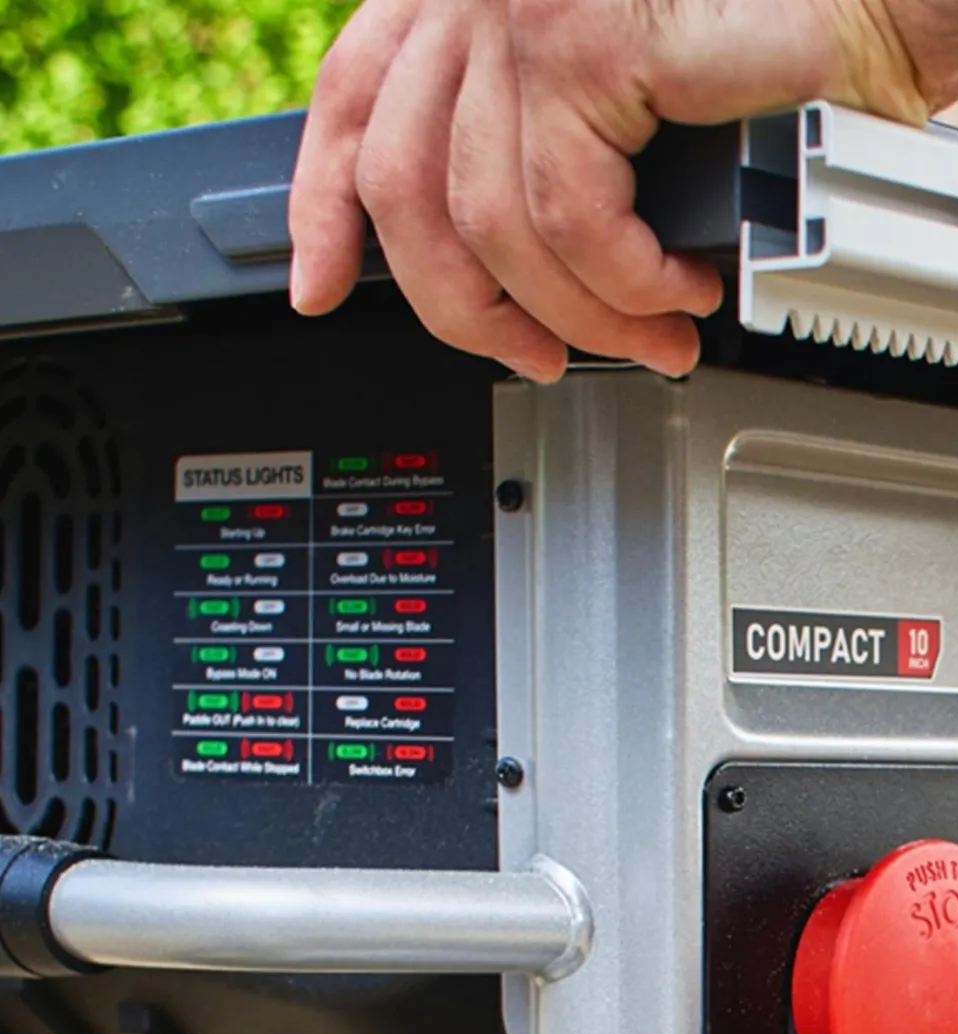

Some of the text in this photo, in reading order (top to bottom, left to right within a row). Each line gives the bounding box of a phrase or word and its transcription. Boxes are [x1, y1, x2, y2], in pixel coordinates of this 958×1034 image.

[183, 464, 304, 488] STATUS LIGHTS
[397, 523, 412, 536] Key
[414, 523, 436, 535] Error
[370, 572, 387, 585] Due
[336, 620, 359, 633] Small
[746, 622, 929, 665] COMPACT 10
[906, 860, 948, 892] PUSH
